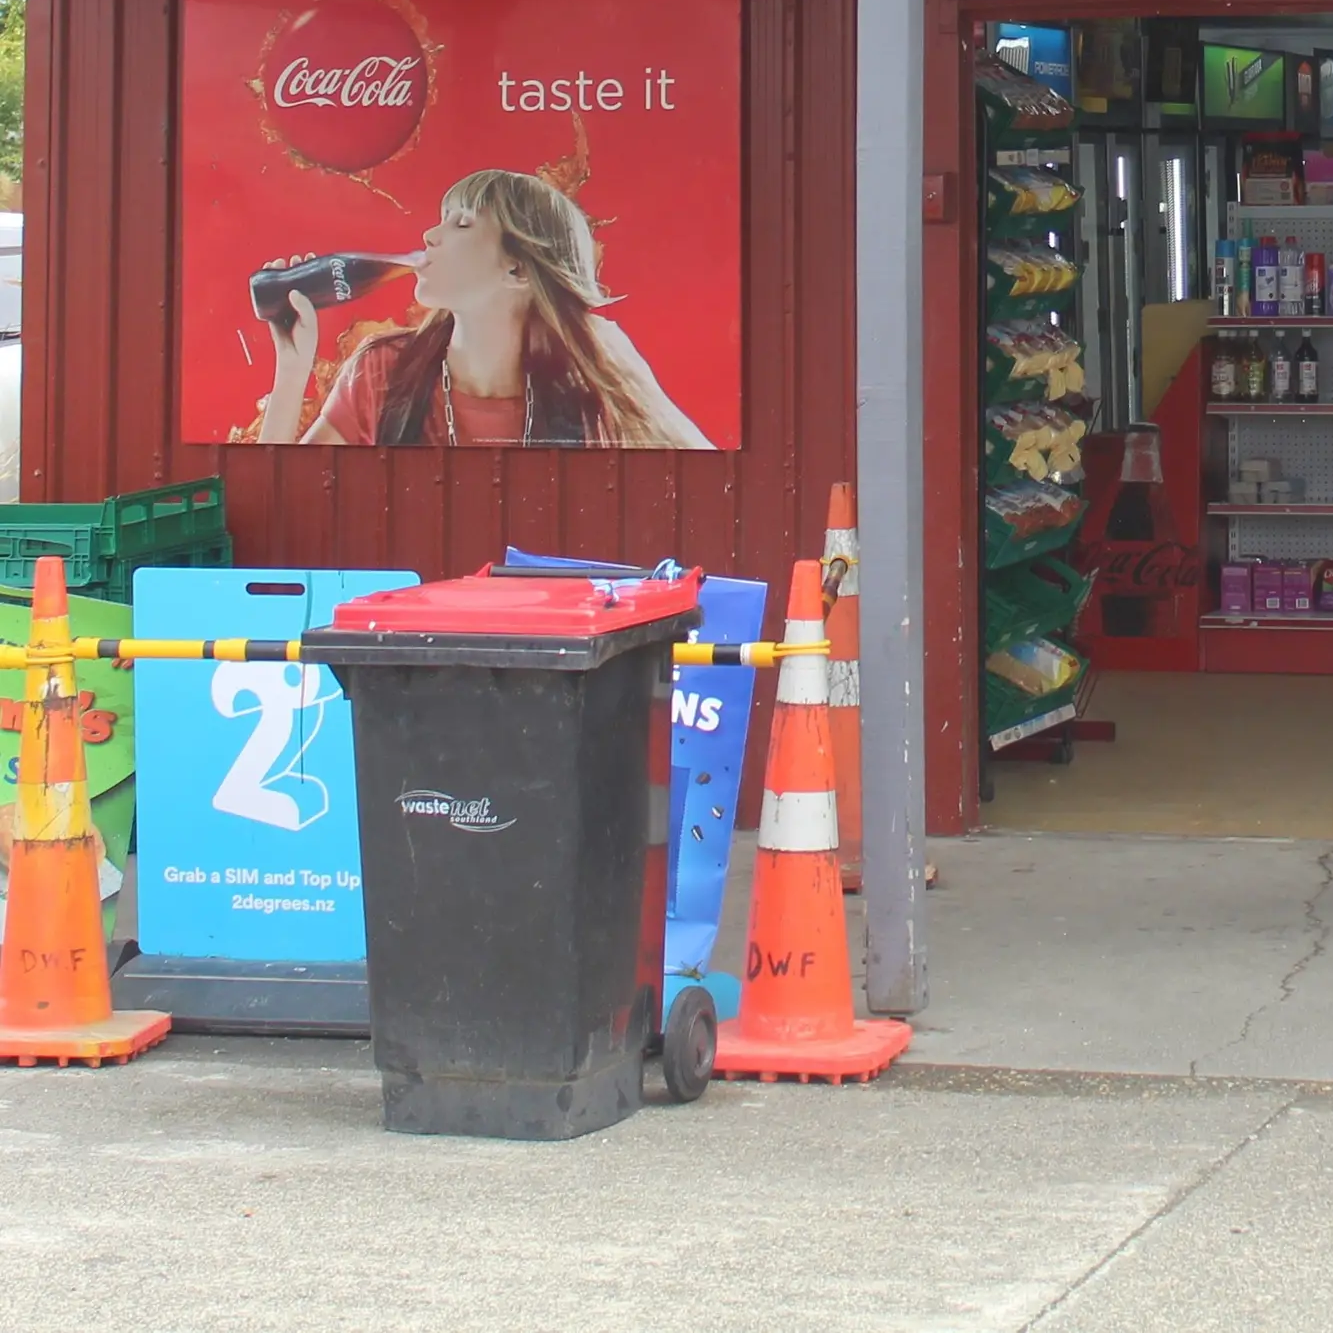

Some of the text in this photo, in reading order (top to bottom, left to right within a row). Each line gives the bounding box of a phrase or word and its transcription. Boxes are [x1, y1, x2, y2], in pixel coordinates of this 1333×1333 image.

[274, 56, 420, 107] Coca-Cola
[498, 67, 675, 112] taste it
[450, 815, 498, 824] southland
[164, 866, 361, 891] Grab a SIM and Top Up
[232, 894, 335, 914] 2degrees.nz
